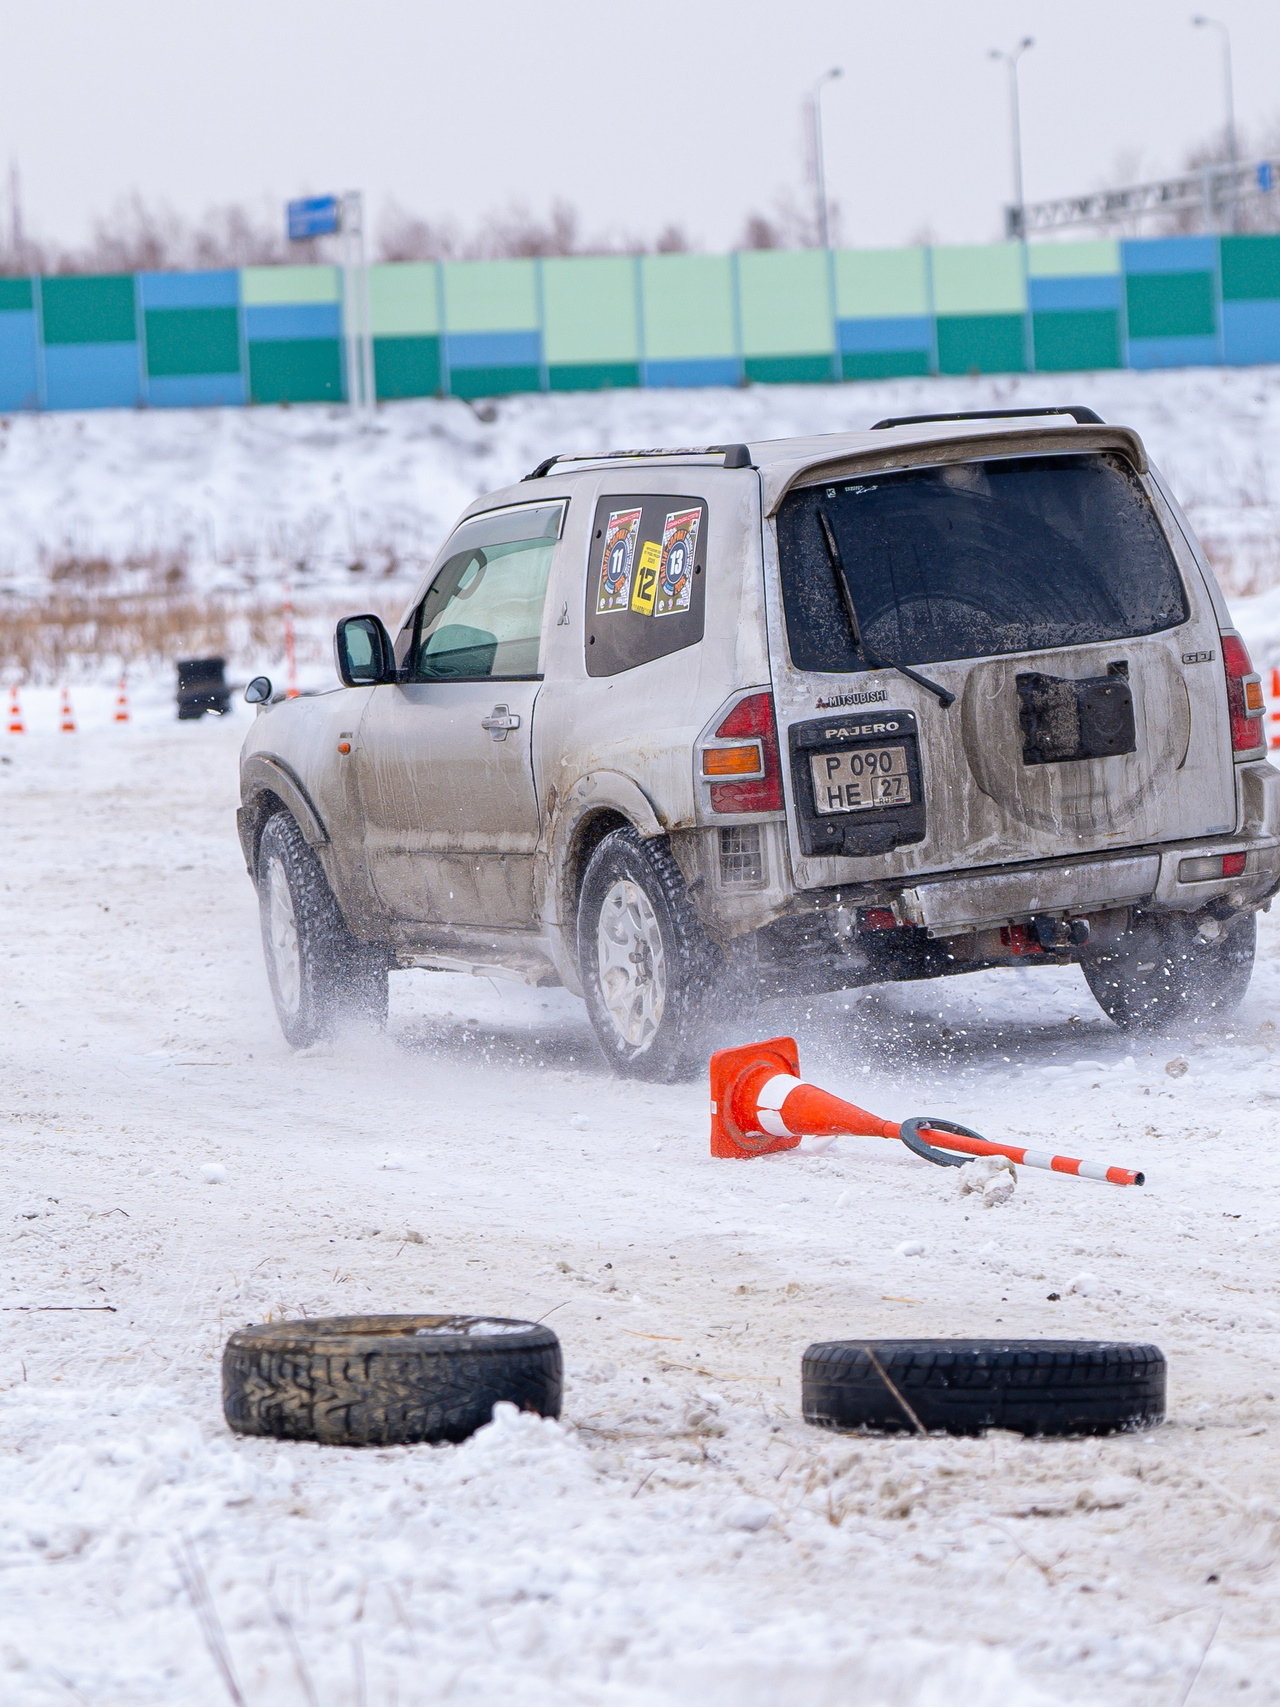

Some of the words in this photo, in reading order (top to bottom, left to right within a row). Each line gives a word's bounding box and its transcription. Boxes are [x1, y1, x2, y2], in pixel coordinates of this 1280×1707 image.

[612, 549, 624, 574] 11
[670, 549, 684, 575] 13
[637, 567, 656, 601] 12
[828, 690, 887, 707] MITSUBISHI
[825, 721, 899, 739] PAJERO
[850, 751, 892, 776] 090
[881, 777, 902, 797] 27
